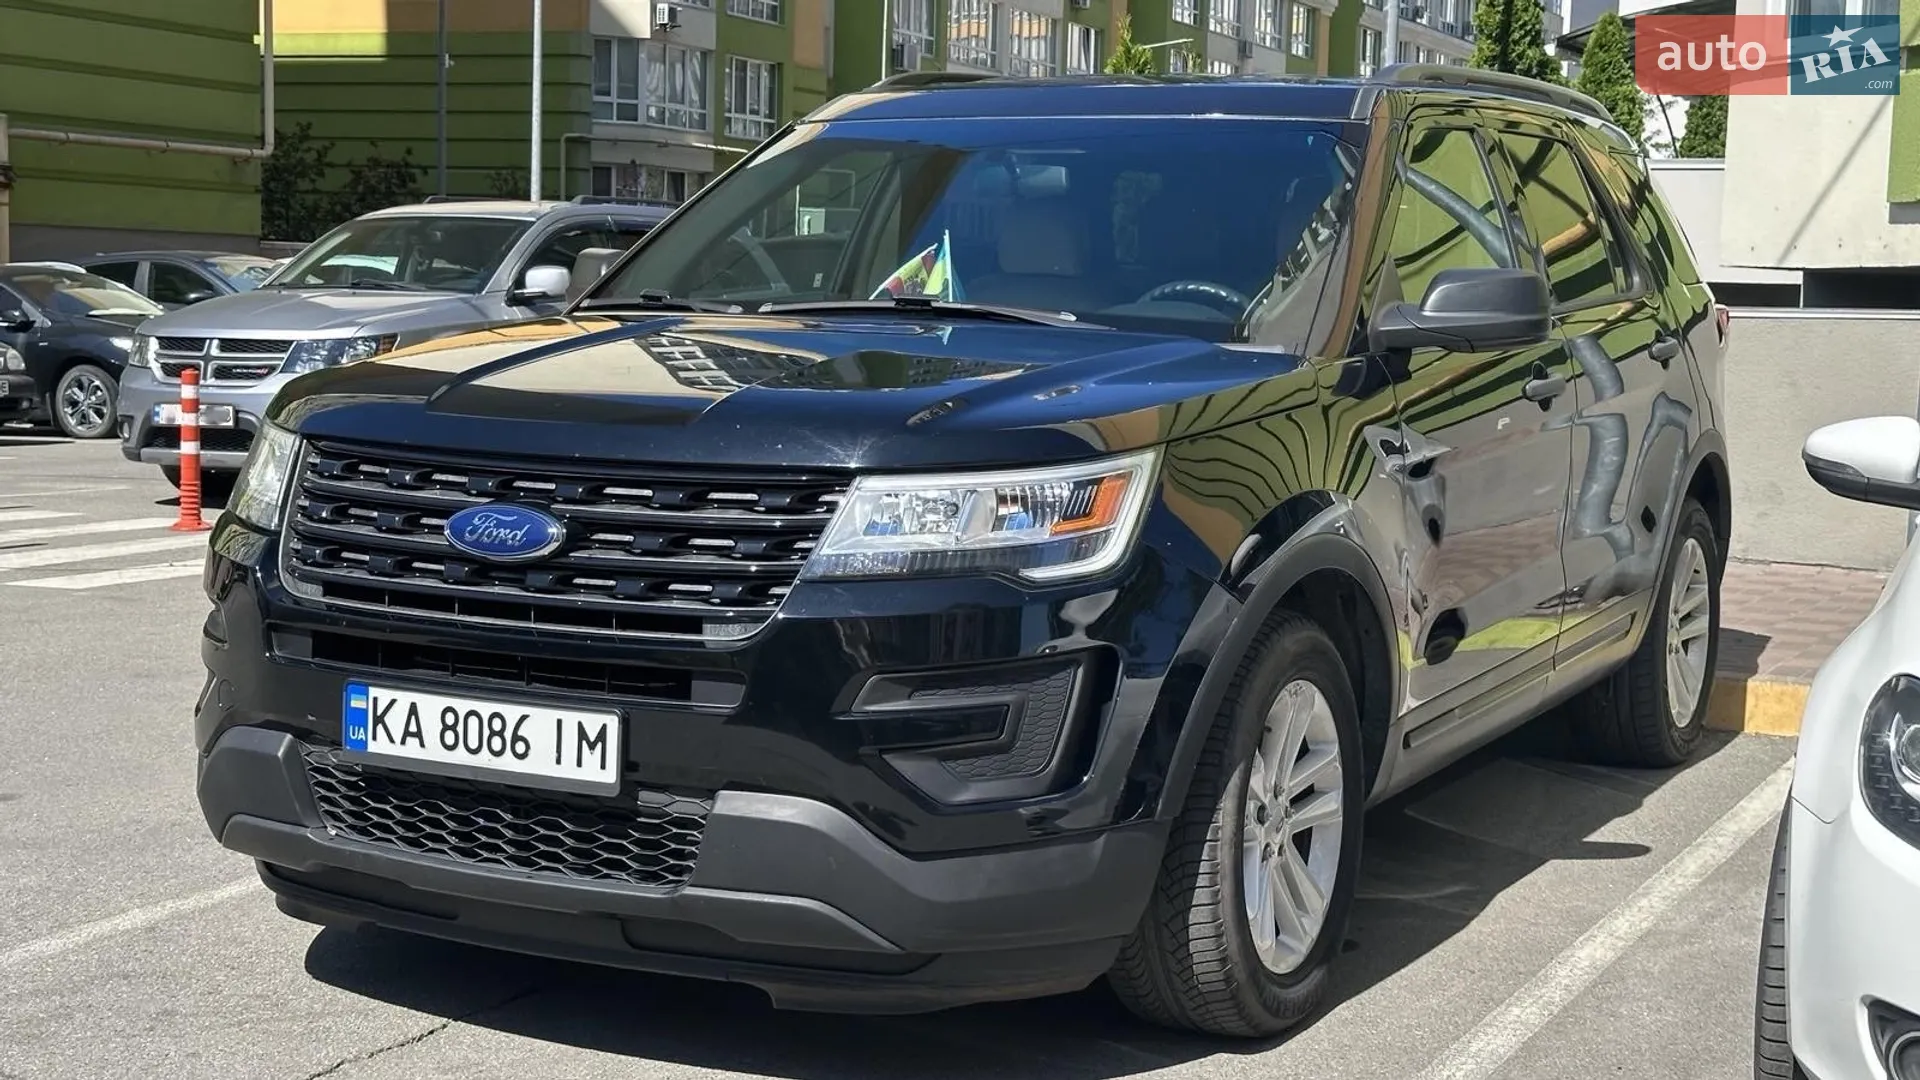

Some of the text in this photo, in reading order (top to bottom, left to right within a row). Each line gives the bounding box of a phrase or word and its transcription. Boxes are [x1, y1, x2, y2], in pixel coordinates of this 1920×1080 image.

[464, 512, 531, 546] Ford
[350, 725, 366, 741] UA
[371, 696, 608, 770] KA 8086 IM
